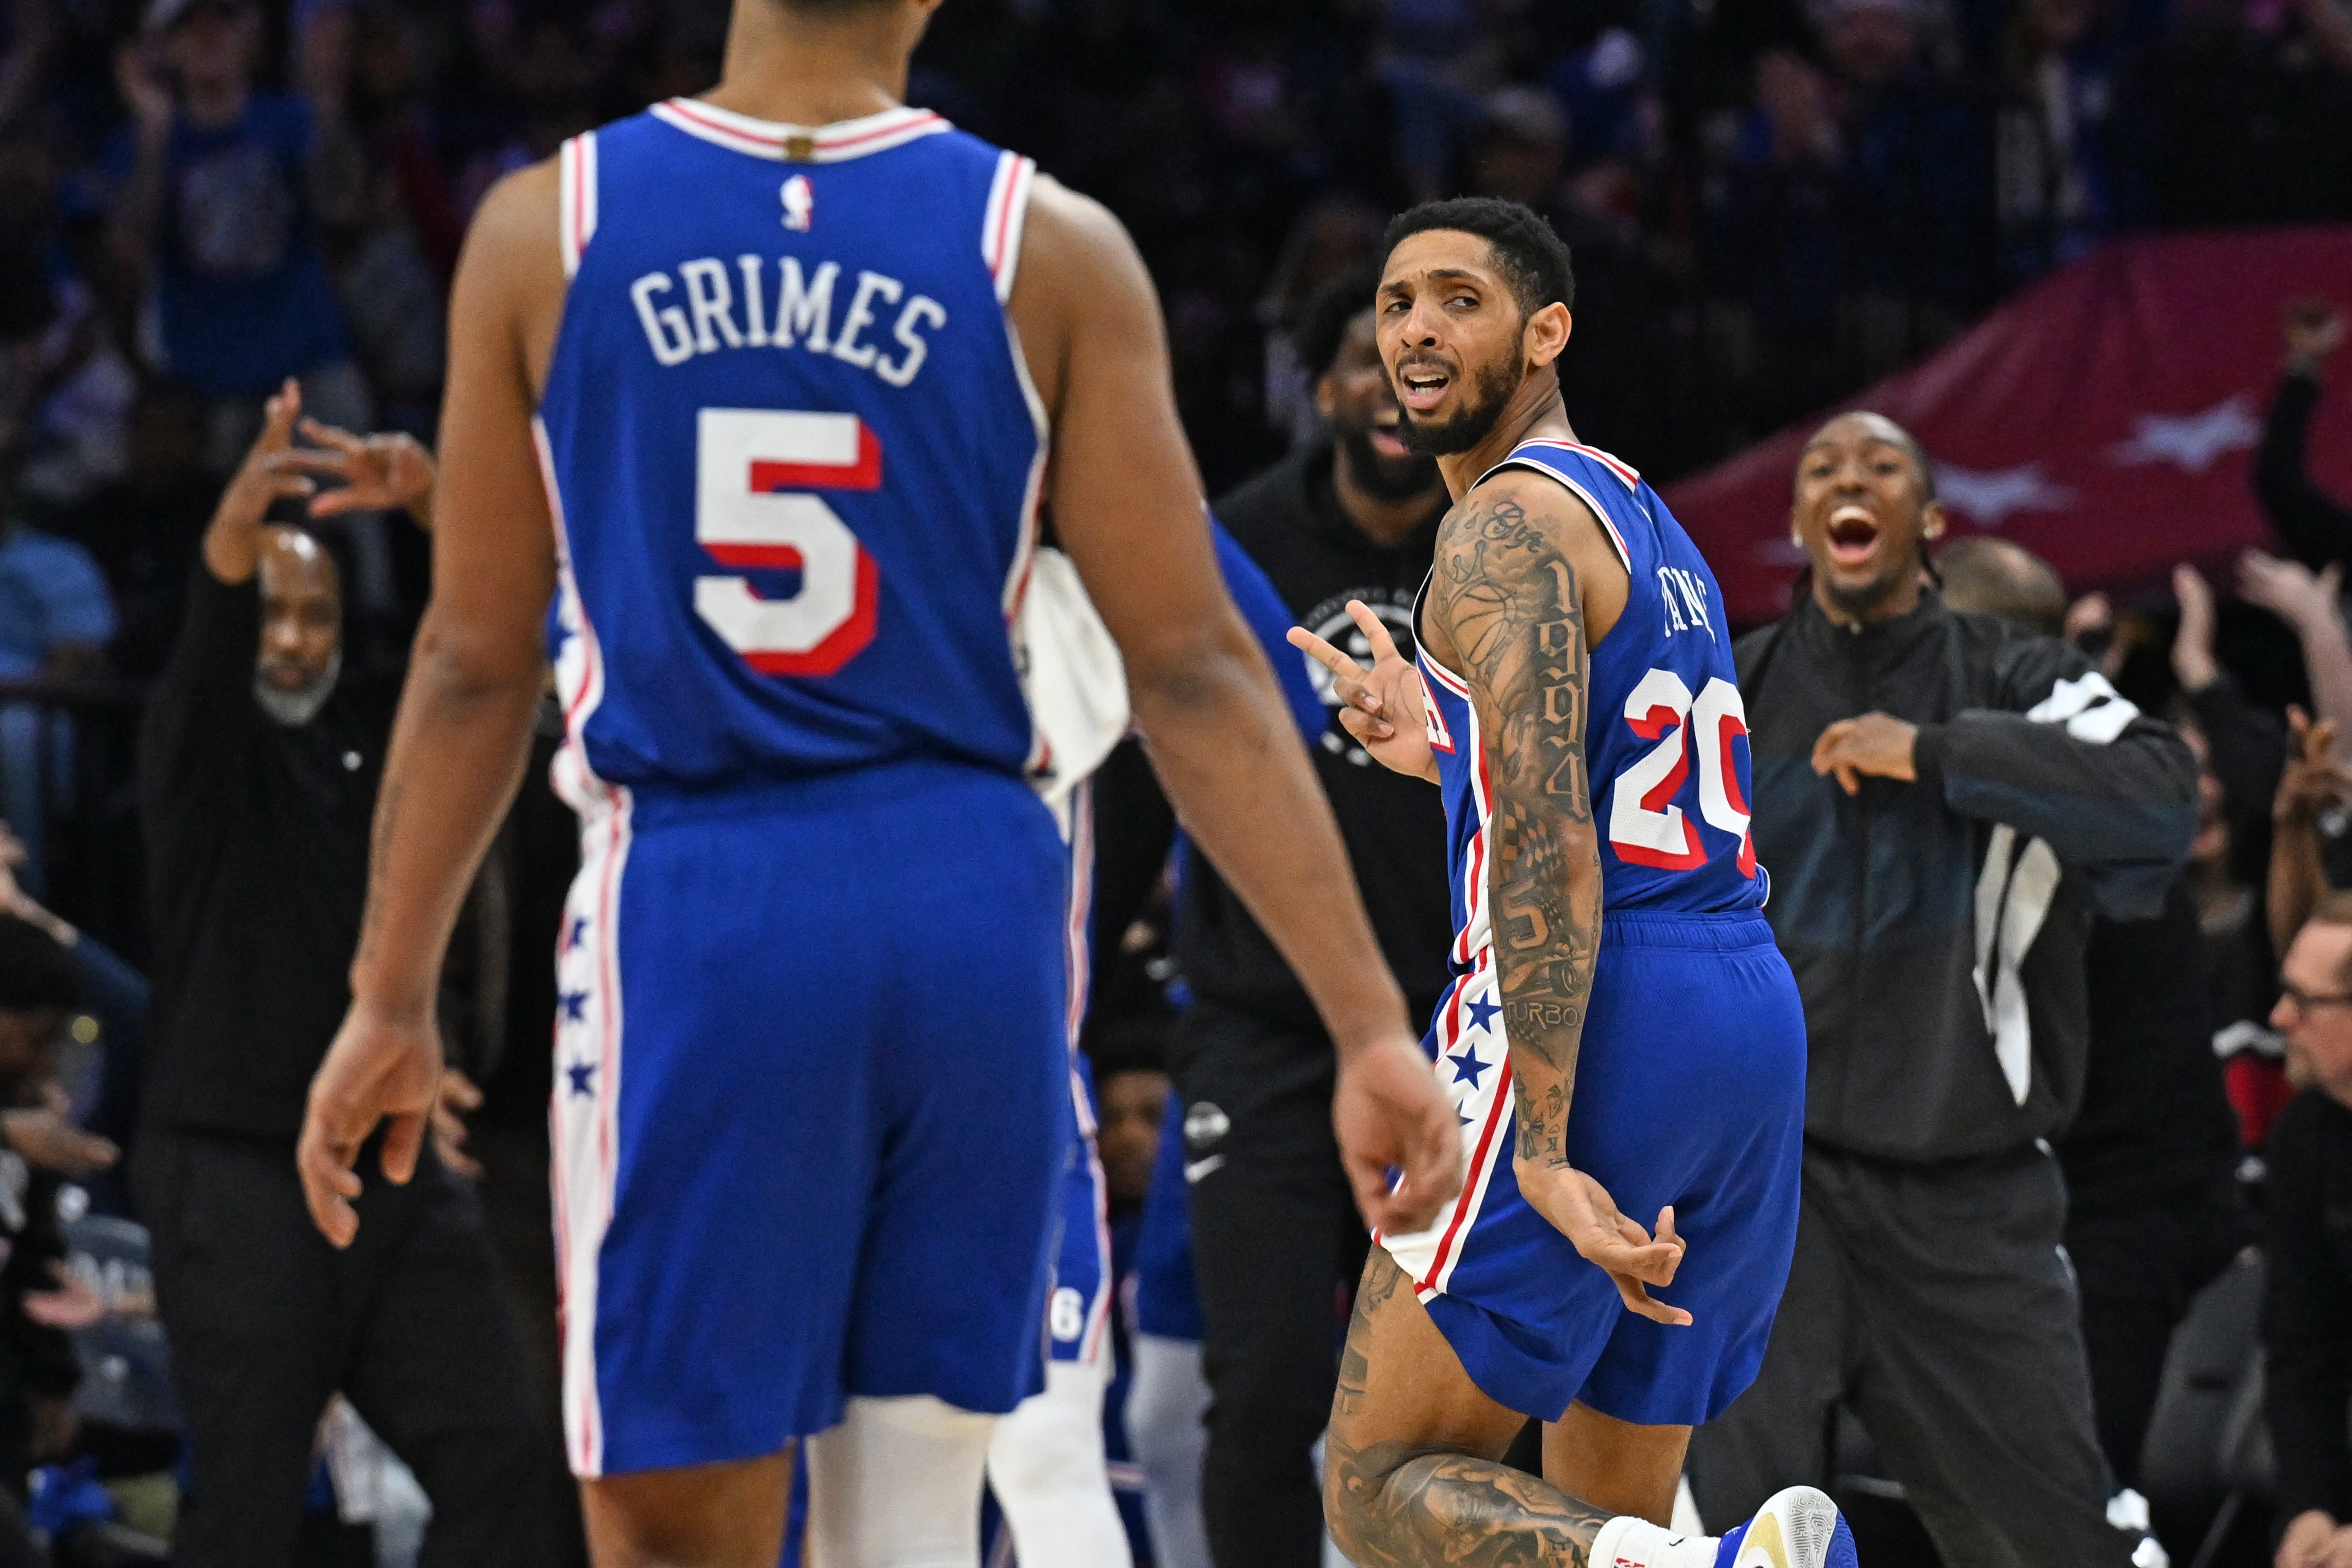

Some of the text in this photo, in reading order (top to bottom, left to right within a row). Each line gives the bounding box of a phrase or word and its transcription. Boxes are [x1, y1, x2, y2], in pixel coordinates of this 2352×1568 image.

[630, 254, 947, 387] GRIMES
[695, 407, 882, 676] 5
[1540, 559, 1588, 819] 1994
[1609, 667, 1755, 879] 20
[1505, 1001, 1578, 1030] TURBO
